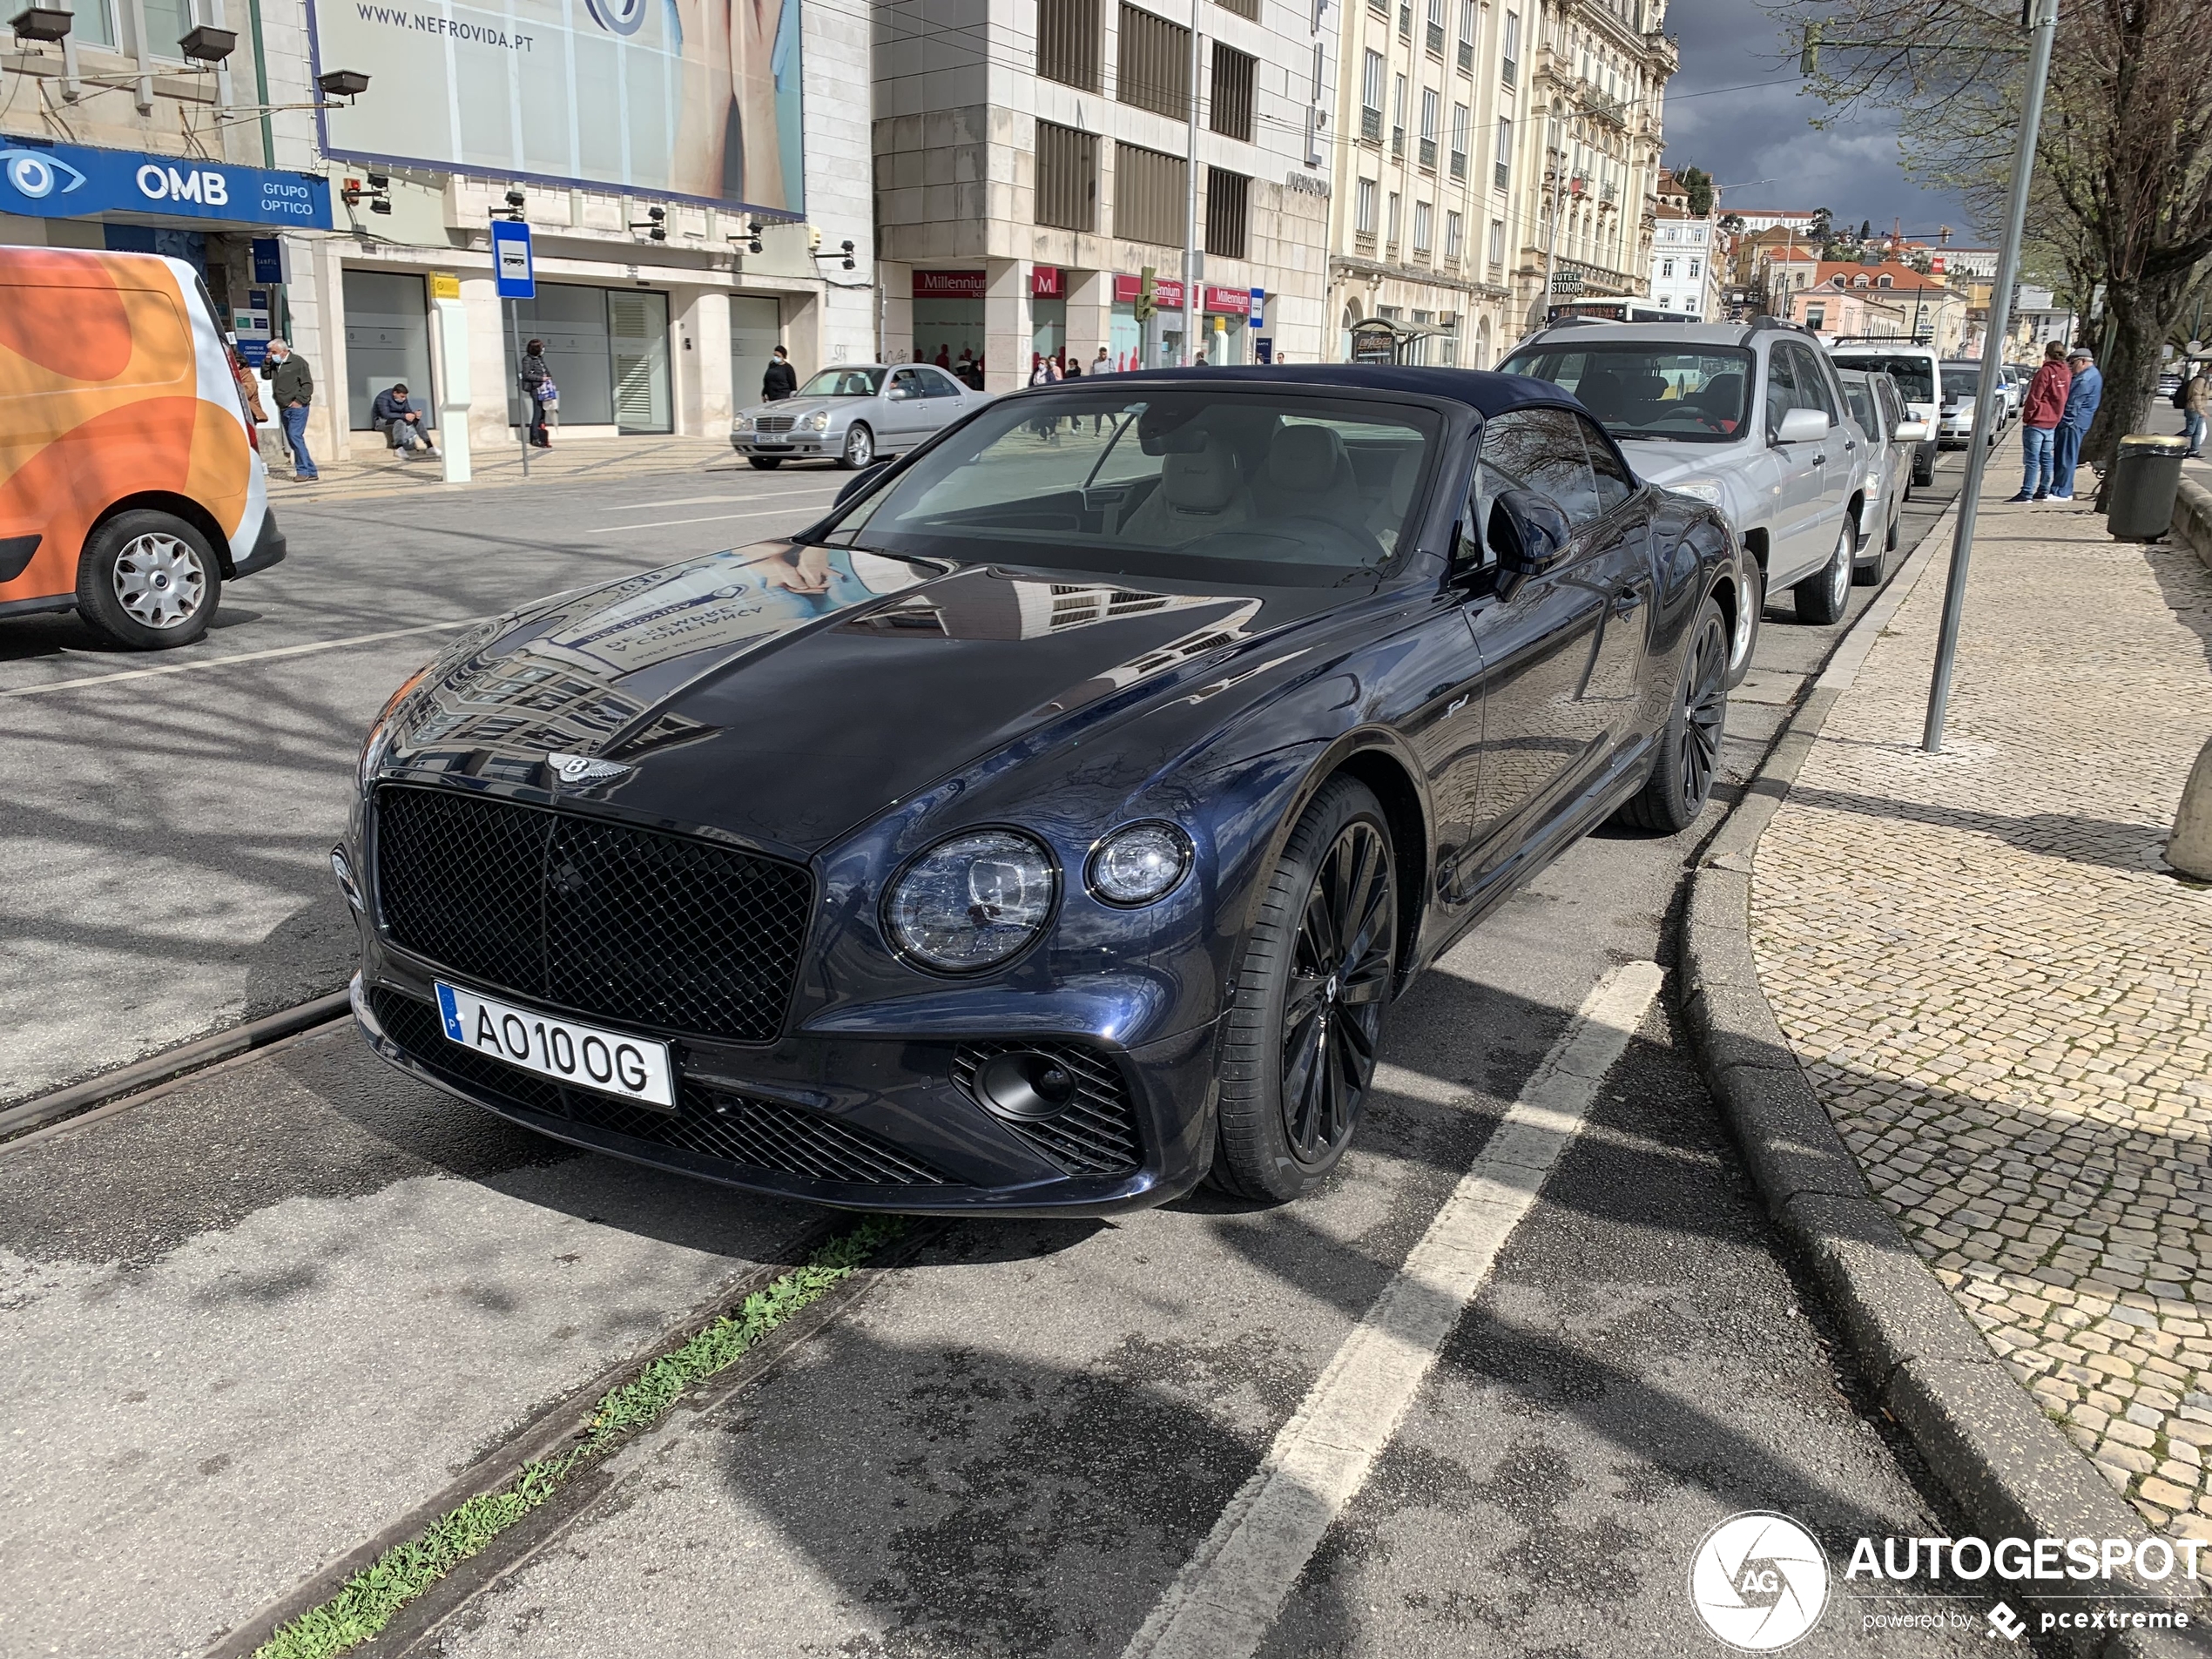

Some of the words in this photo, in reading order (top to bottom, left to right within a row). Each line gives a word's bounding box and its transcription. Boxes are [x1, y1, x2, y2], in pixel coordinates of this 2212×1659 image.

[356, 3, 534, 52] WWW.NEFROVIDA.PT
[136, 164, 228, 206] OMB
[1038, 275, 1052, 293] M
[1150, 283, 1180, 297] ennium
[1551, 282, 1584, 293] STORIA
[1217, 287, 1248, 305] Millennium
[448, 1018, 456, 1031] P
